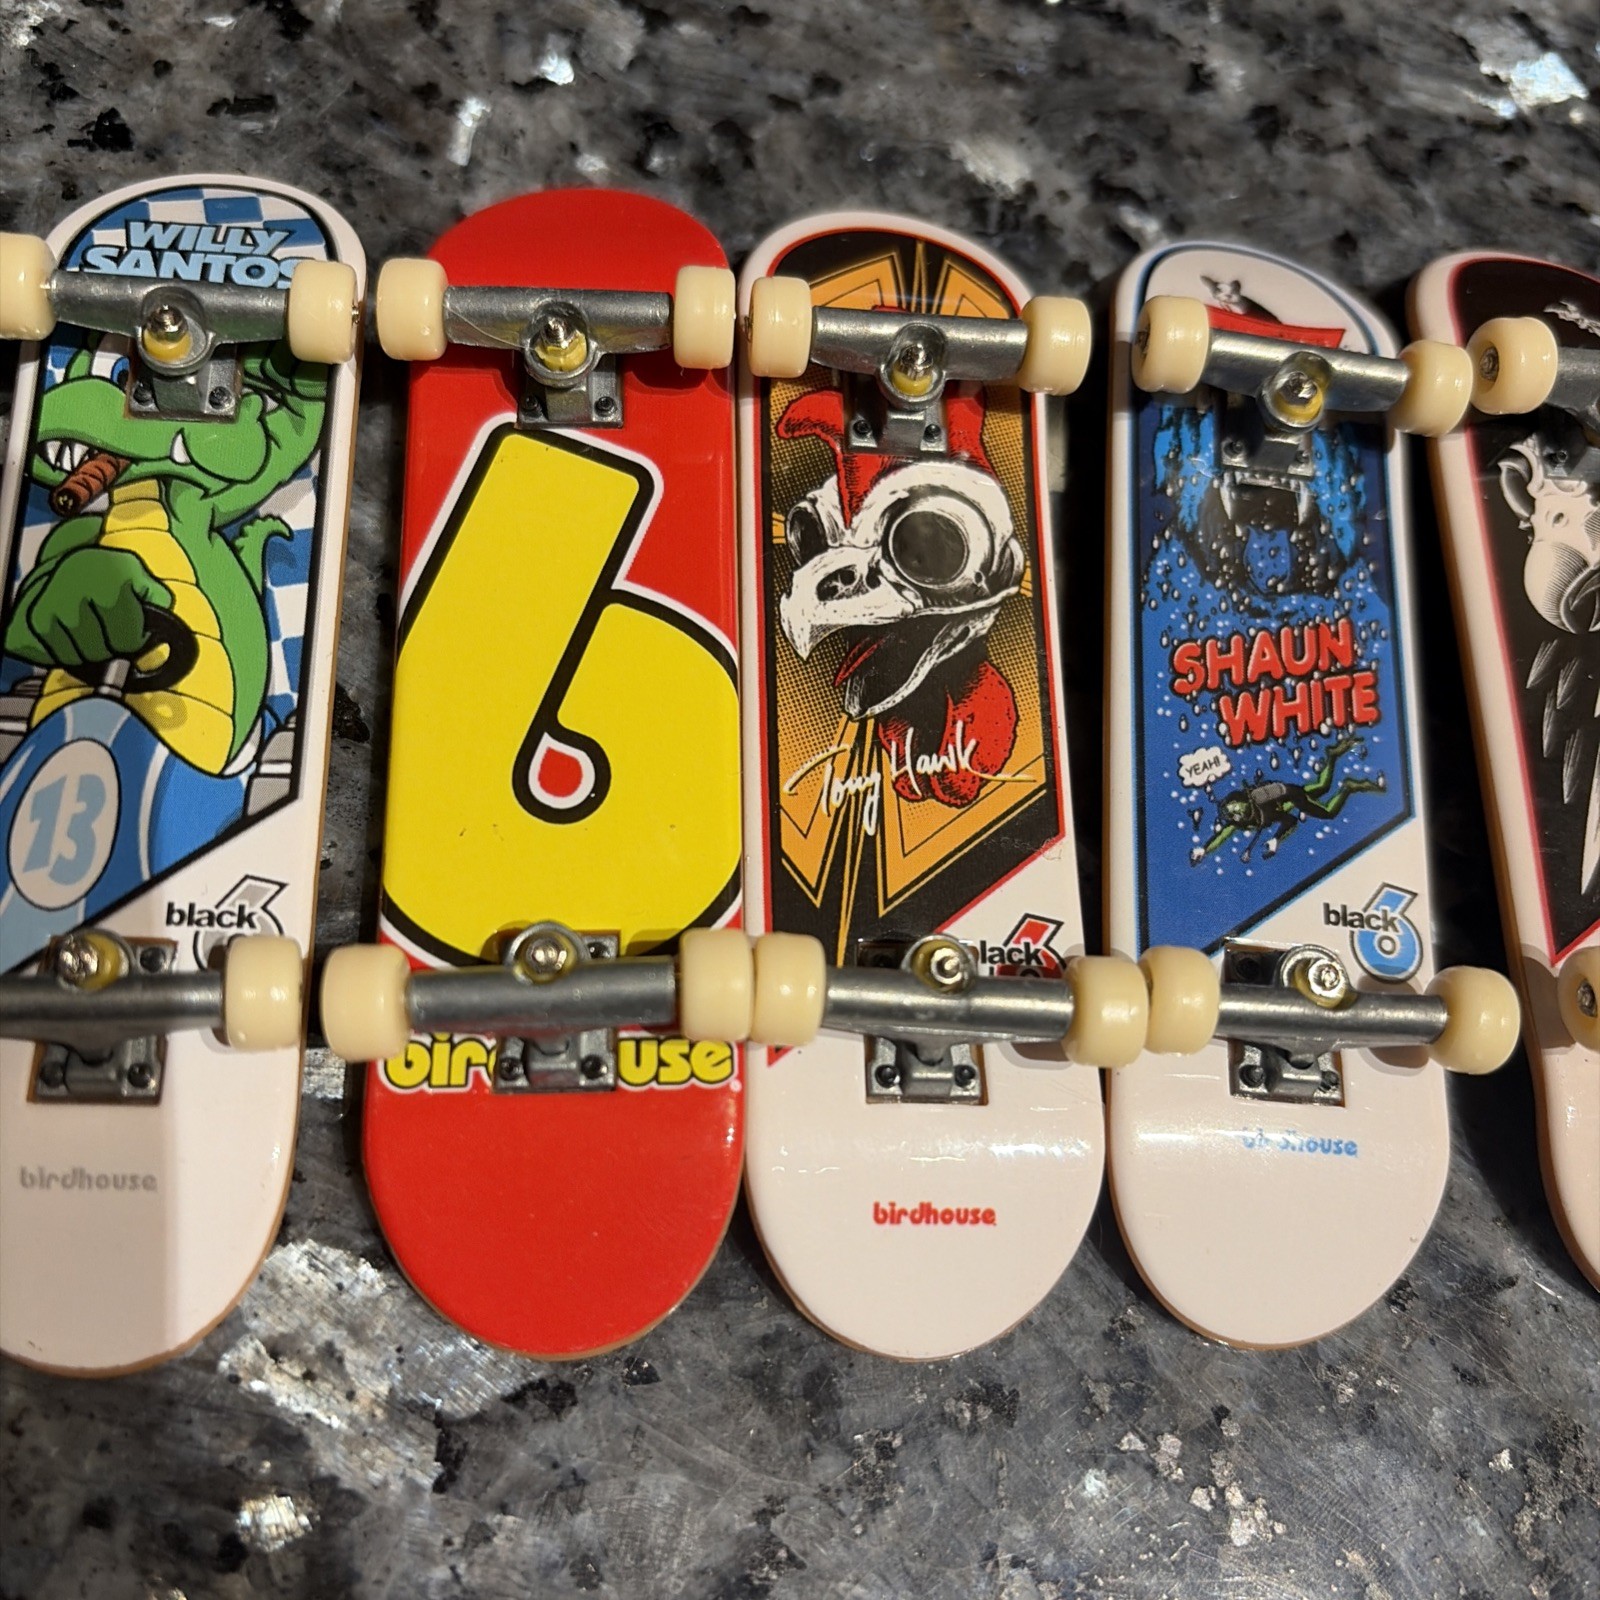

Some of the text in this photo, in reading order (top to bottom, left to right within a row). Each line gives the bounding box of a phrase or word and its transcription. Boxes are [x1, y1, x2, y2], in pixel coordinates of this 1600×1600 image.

[127, 220, 291, 256] WILLY
[1171, 616, 1356, 696] SHAUN
[1217, 670, 1381, 747] WHITE
[783, 719, 1037, 836] Tony Hawk
[22, 772, 108, 888] 13
[166, 900, 259, 932] black
[1322, 882, 1424, 983] black 6
[979, 939, 1044, 965] lack
[383, 1031, 735, 1089] biruse
[20, 1165, 158, 1192] birdhouse
[873, 1201, 996, 1226] birdhouse
